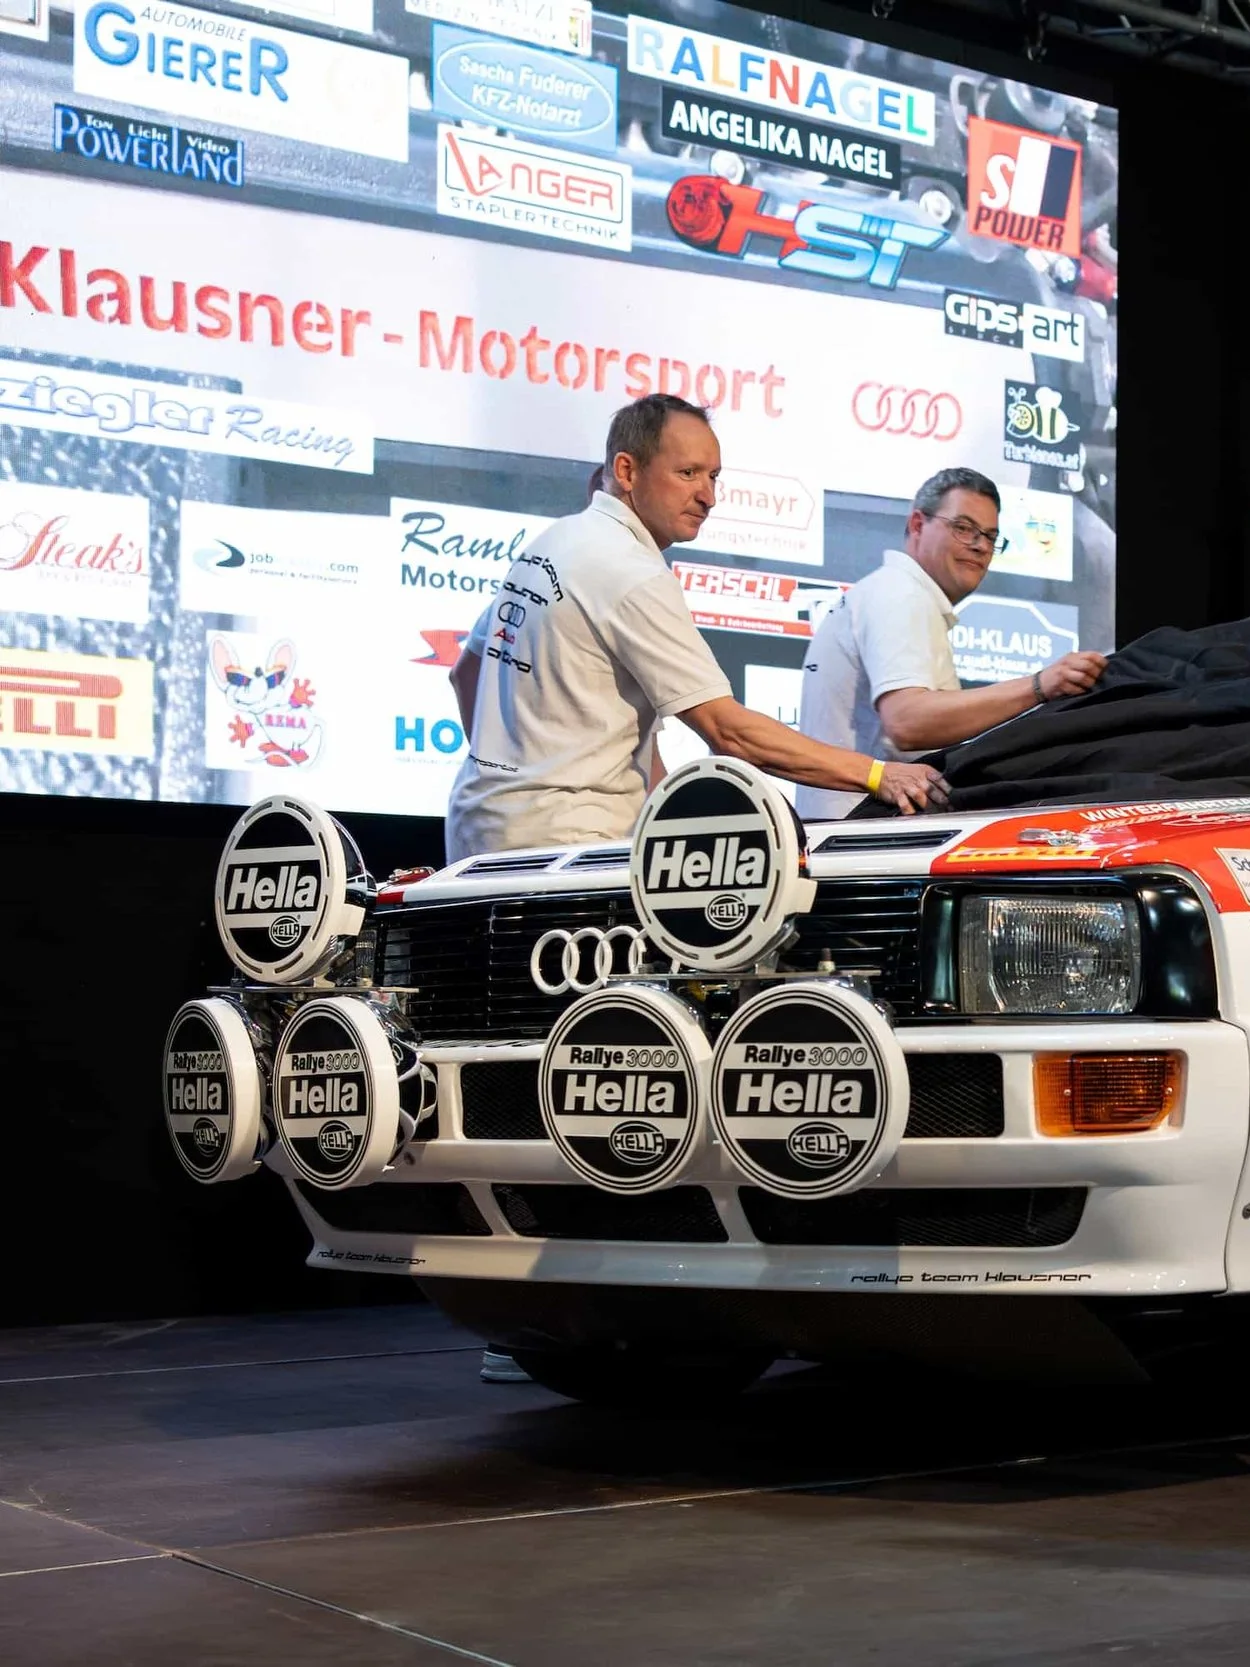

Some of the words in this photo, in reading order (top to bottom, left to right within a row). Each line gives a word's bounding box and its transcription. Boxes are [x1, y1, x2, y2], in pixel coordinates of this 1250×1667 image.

[141, 6, 246, 42] AUTOMOBILE
[84, 2, 289, 102] GIERER
[459, 55, 515, 85] Sascha
[519, 65, 595, 102] Fuderer
[635, 24, 928, 137] RALFNAGEL
[471, 83, 584, 128] KFZ-Notarzt
[669, 100, 803, 158] ANGELIKA
[809, 132, 894, 180] NAGEL
[450, 196, 620, 240] STAPLERTECHNIK
[973, 205, 1066, 251] POWER
[225, 404, 356, 467] Racing
[677, 565, 786, 602] TERSCHL
[947, 624, 1053, 659] DI-KLAUS
[646, 836, 766, 890] Hella
[226, 865, 318, 911] Hella
[708, 902, 747, 919] HELLA
[271, 923, 300, 937] HELLA
[173, 1052, 196, 1071] Rallye
[197, 1052, 223, 1070] 3000
[291, 1053, 325, 1074] Rallye
[326, 1052, 360, 1070] 3000
[569, 1046, 624, 1068] Rallye
[625, 1048, 679, 1068] 3000
[744, 1044, 806, 1066] Rallye
[807, 1046, 868, 1066] 3000
[171, 1076, 223, 1112] Hella
[288, 1077, 359, 1114] Hella
[563, 1073, 676, 1113] Hella
[735, 1073, 863, 1114] Hella
[194, 1127, 220, 1149] HELLA
[320, 1130, 353, 1152] HELLA
[612, 1133, 666, 1155] HELLA
[790, 1134, 852, 1157] HELLA
[850, 1272, 914, 1285] rallye
[921, 1271, 979, 1282] team
[984, 1271, 1092, 1283] klausner
